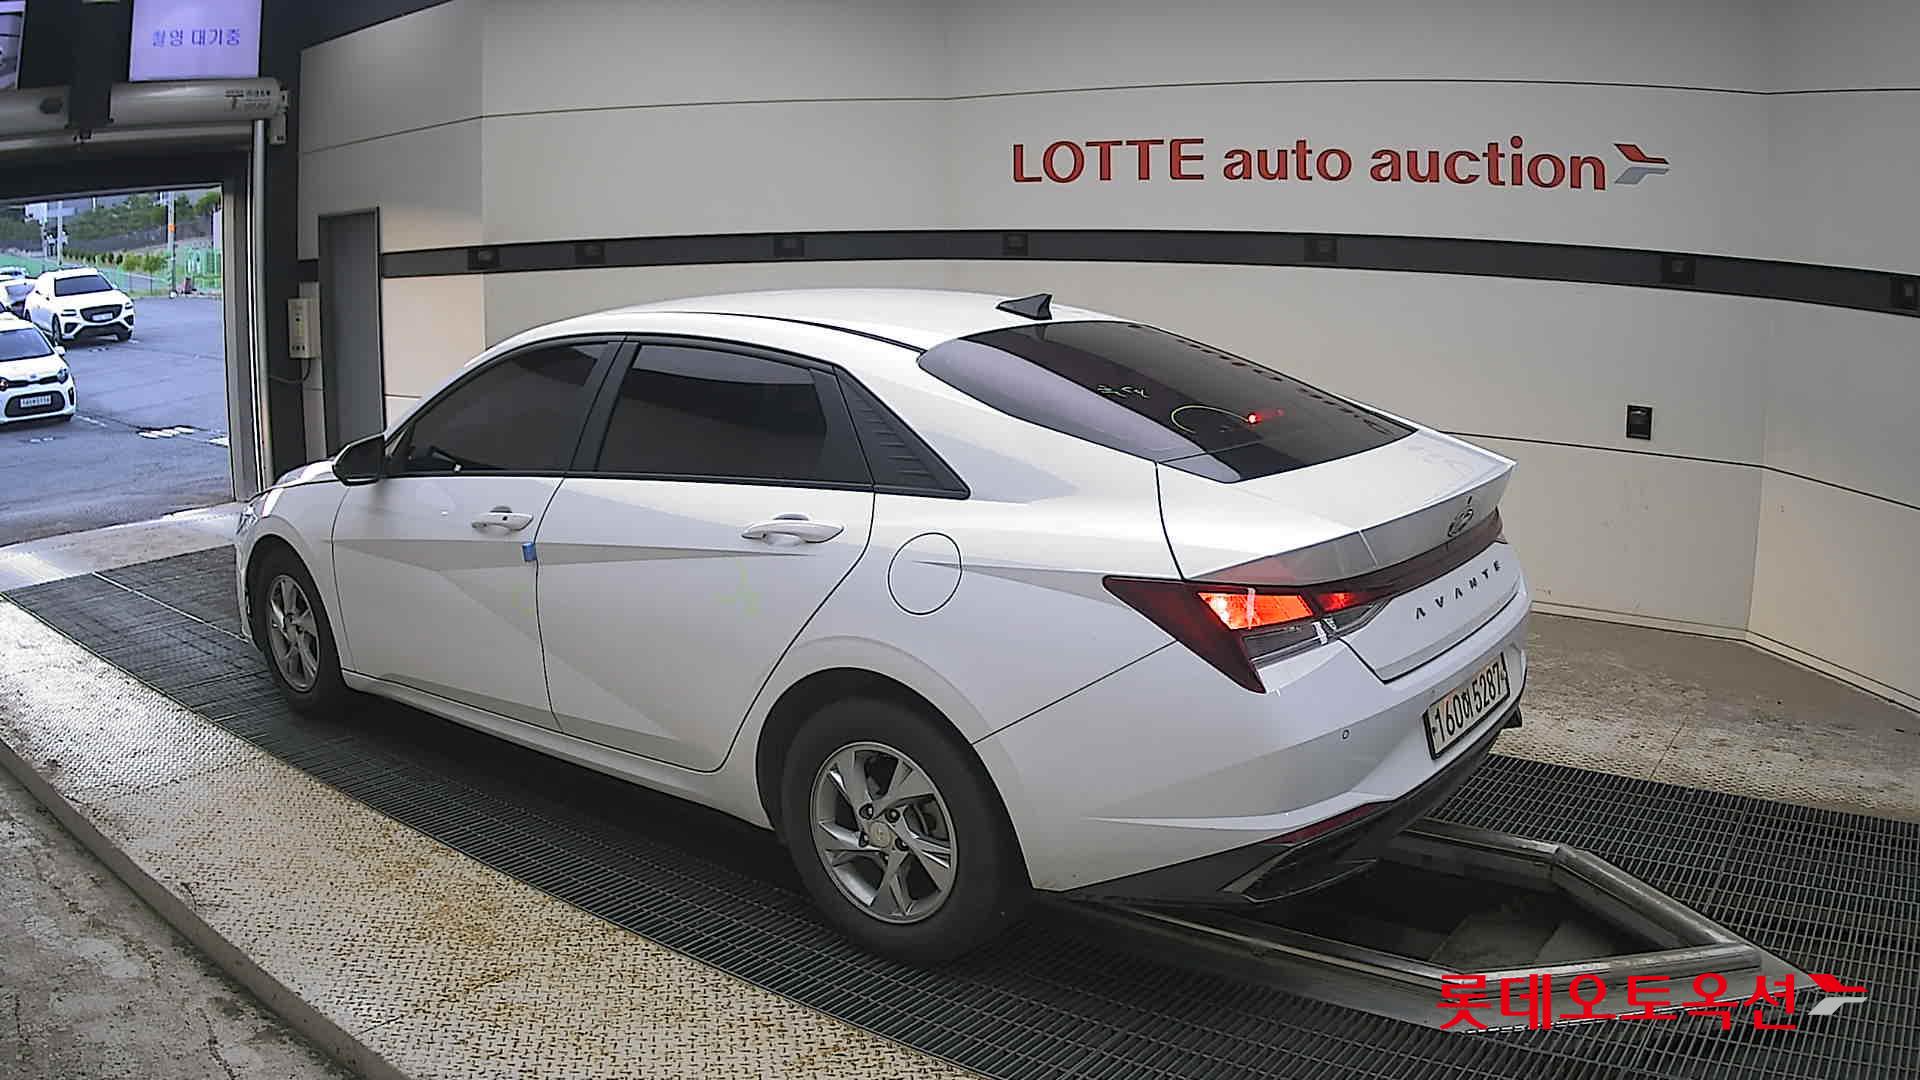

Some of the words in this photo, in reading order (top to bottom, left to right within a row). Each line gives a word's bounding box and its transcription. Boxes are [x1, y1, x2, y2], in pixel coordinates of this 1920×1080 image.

[1013, 138, 1204, 183] LOTTE
[1223, 139, 1352, 181] auto
[1370, 135, 1606, 190] auction
[1415, 560, 1502, 620] AVANTE
